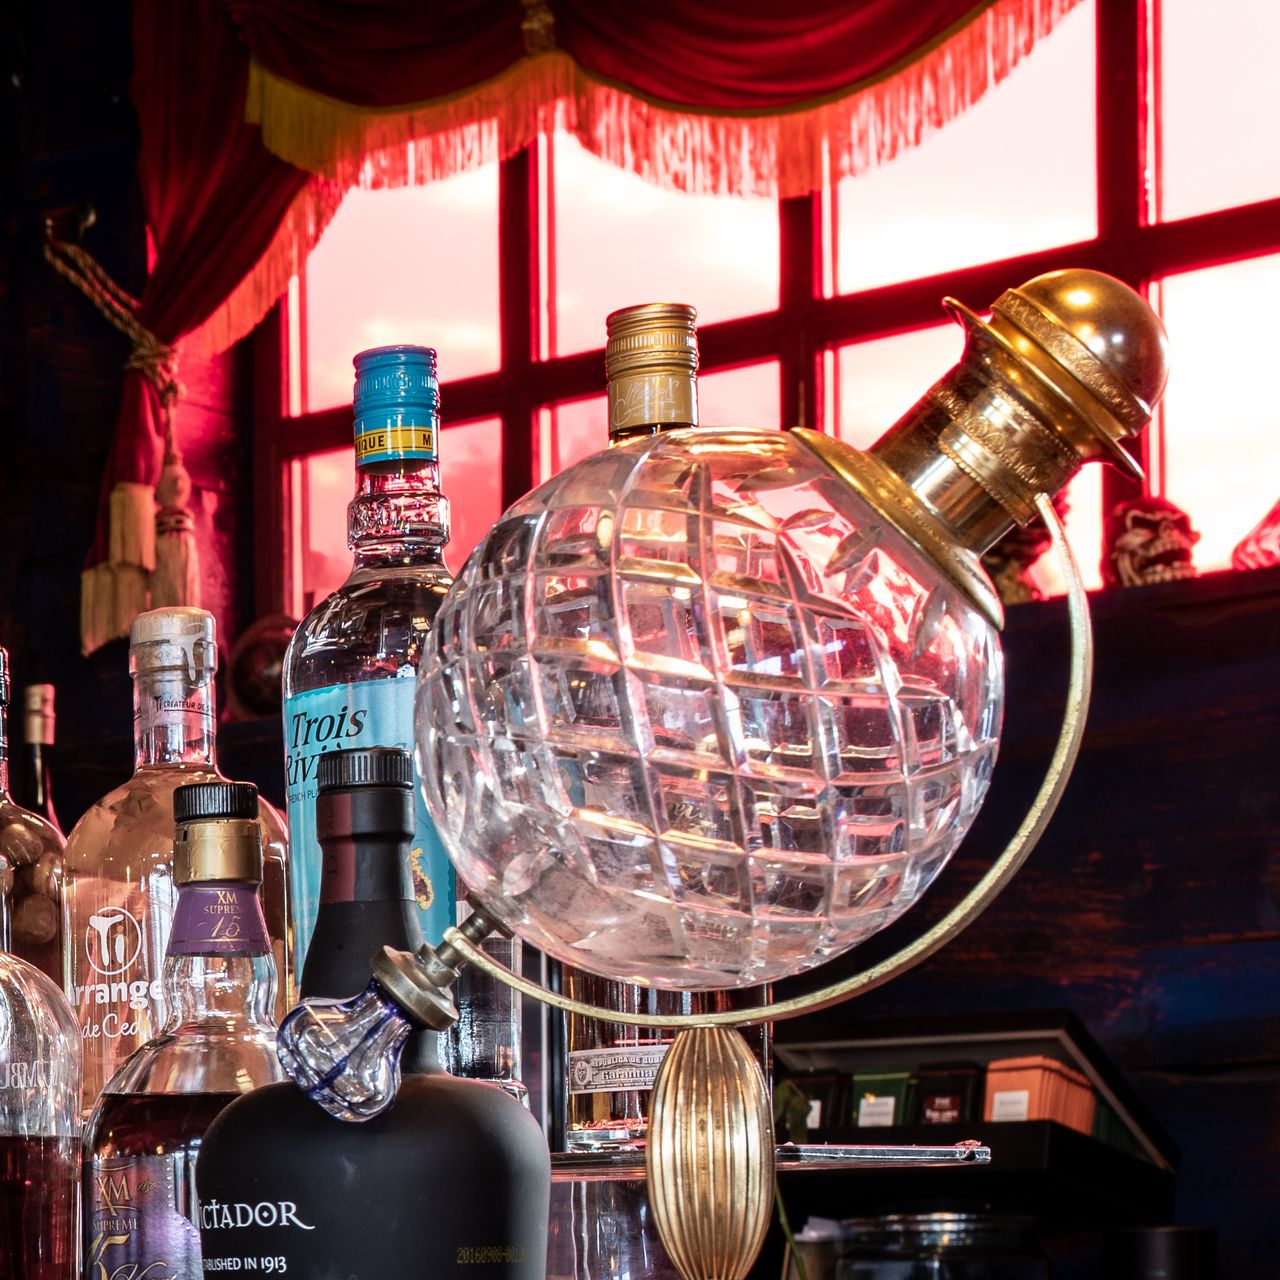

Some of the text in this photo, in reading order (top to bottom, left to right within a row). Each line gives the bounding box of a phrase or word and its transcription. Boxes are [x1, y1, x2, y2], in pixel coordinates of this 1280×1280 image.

[291, 705, 368, 749] Trois
[216, 891, 239, 904] XM
[89, 913, 125, 967] Ti
[244, 1257, 258, 1270] IN
[260, 1256, 287, 1274] 1913
